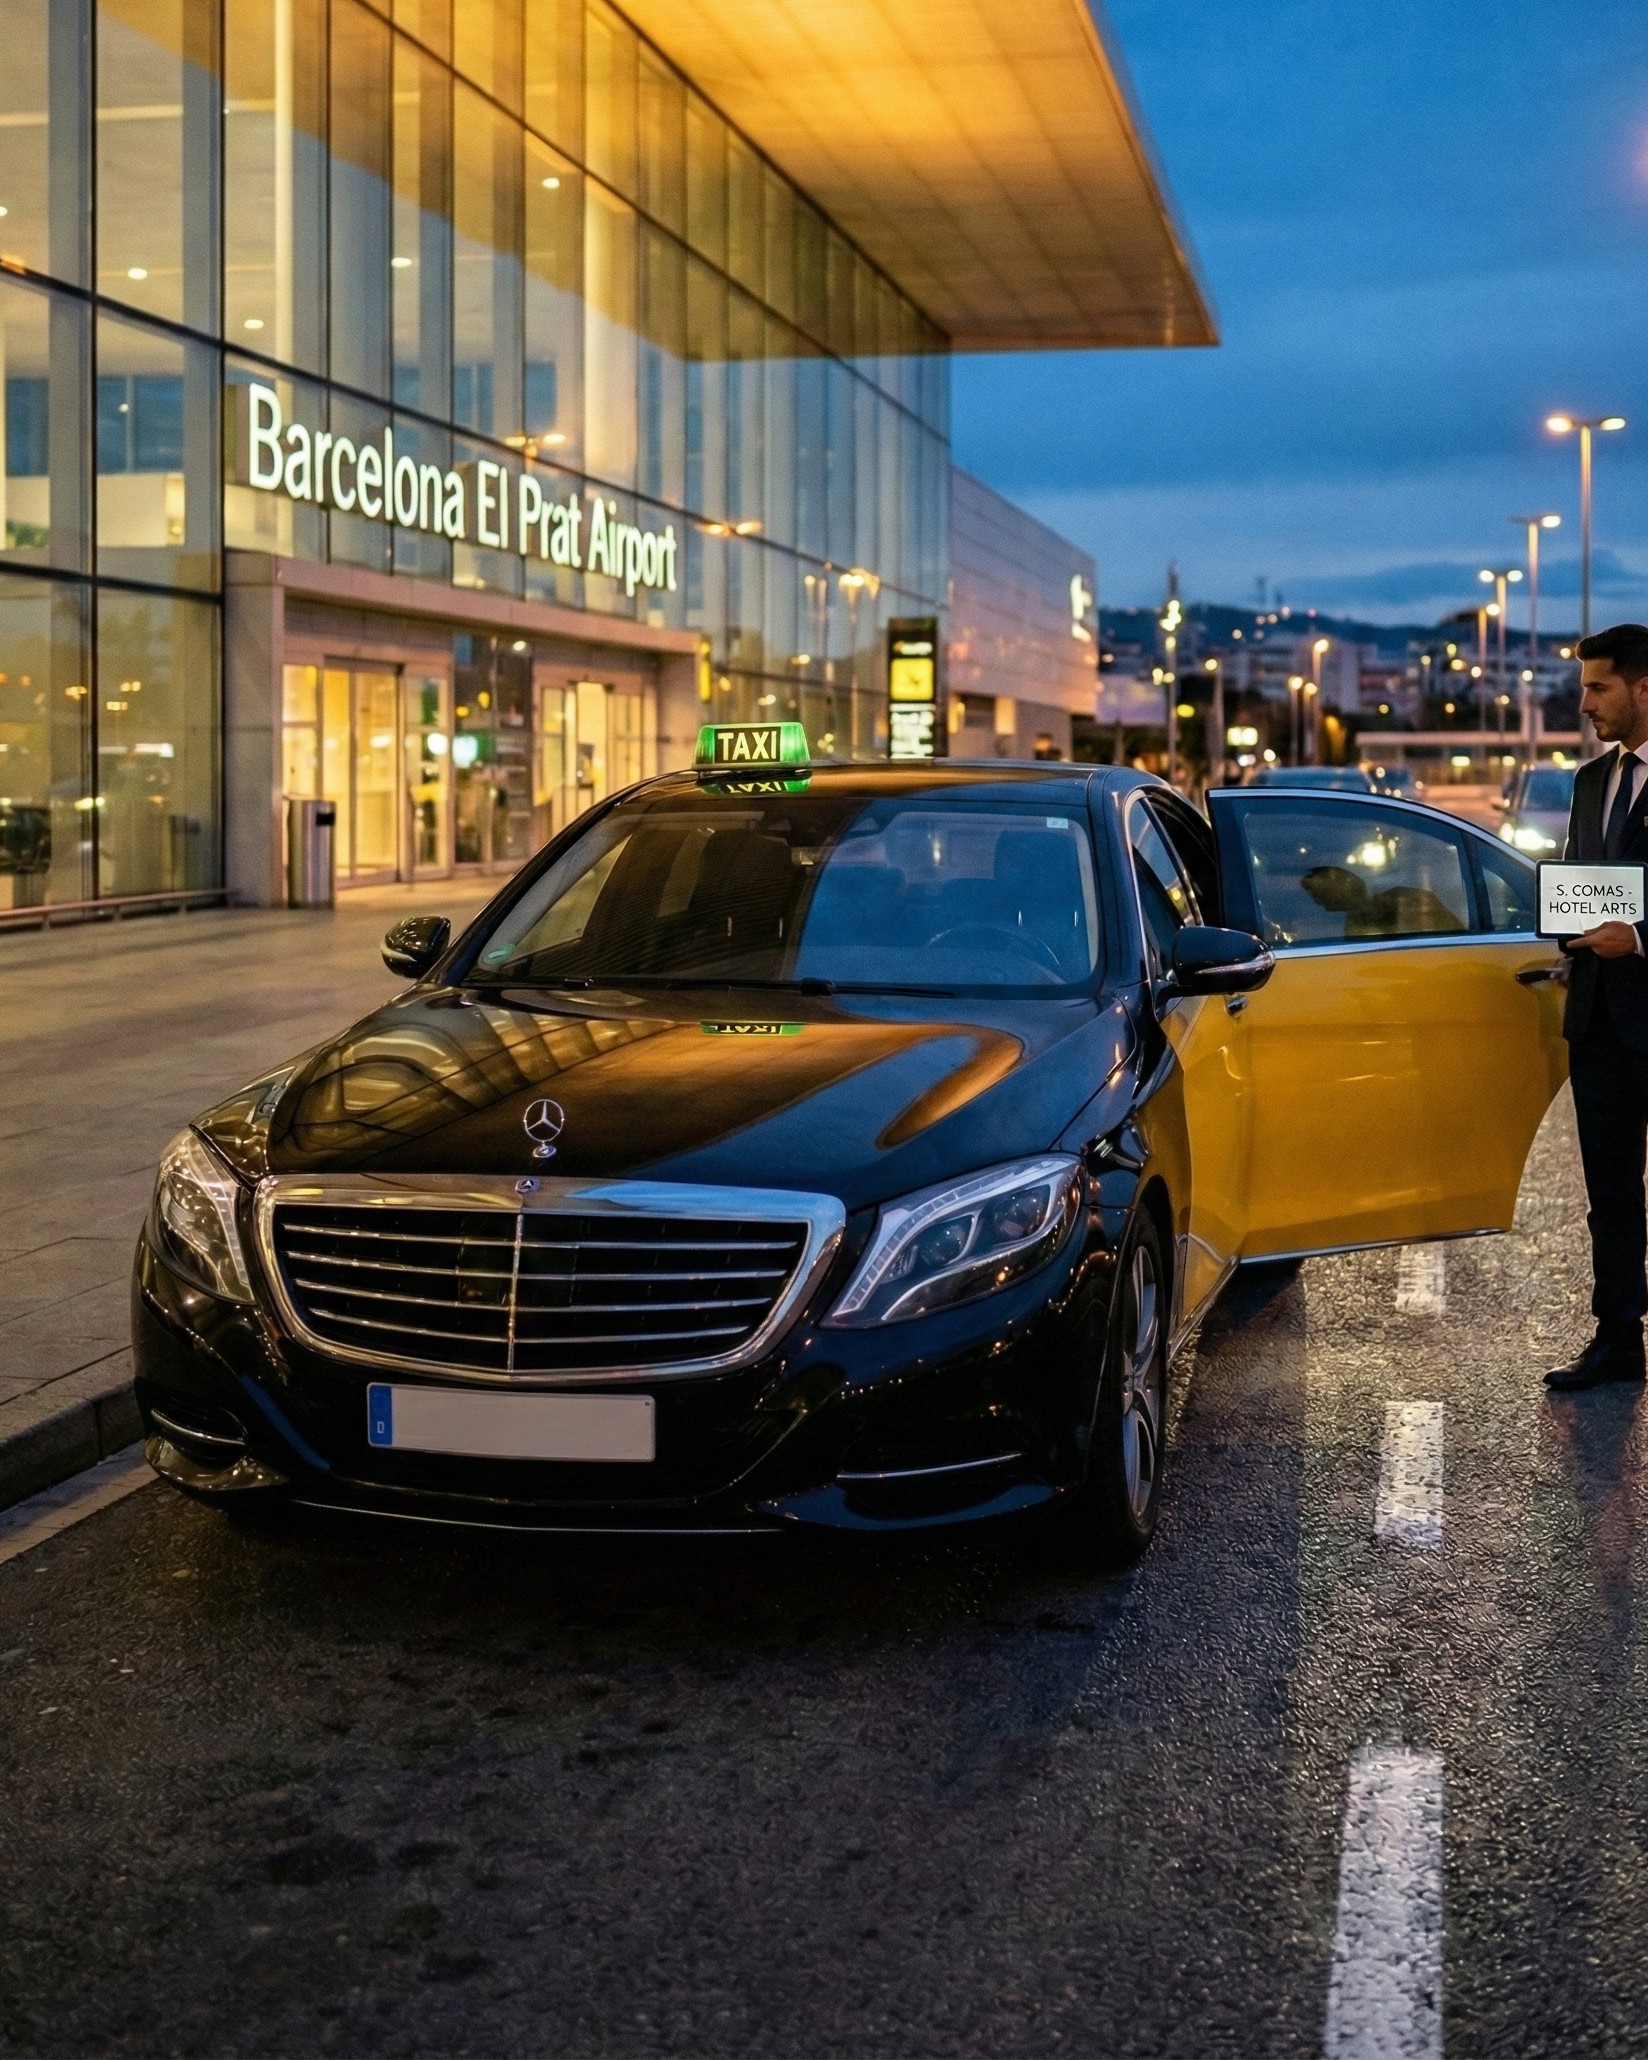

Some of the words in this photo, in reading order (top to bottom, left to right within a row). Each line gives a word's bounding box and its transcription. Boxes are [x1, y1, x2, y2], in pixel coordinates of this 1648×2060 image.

[249, 383, 465, 539] Barcelona
[477, 460, 508, 549] El
[519, 474, 582, 568] Prat
[587, 497, 677, 597] Airport
[717, 731, 777, 761] TAXI
[1556, 884, 1568, 896] S.
[1572, 884, 1624, 897] COMAS
[1549, 901, 1596, 914] HOTEL
[1600, 902, 1637, 915] ARTS
